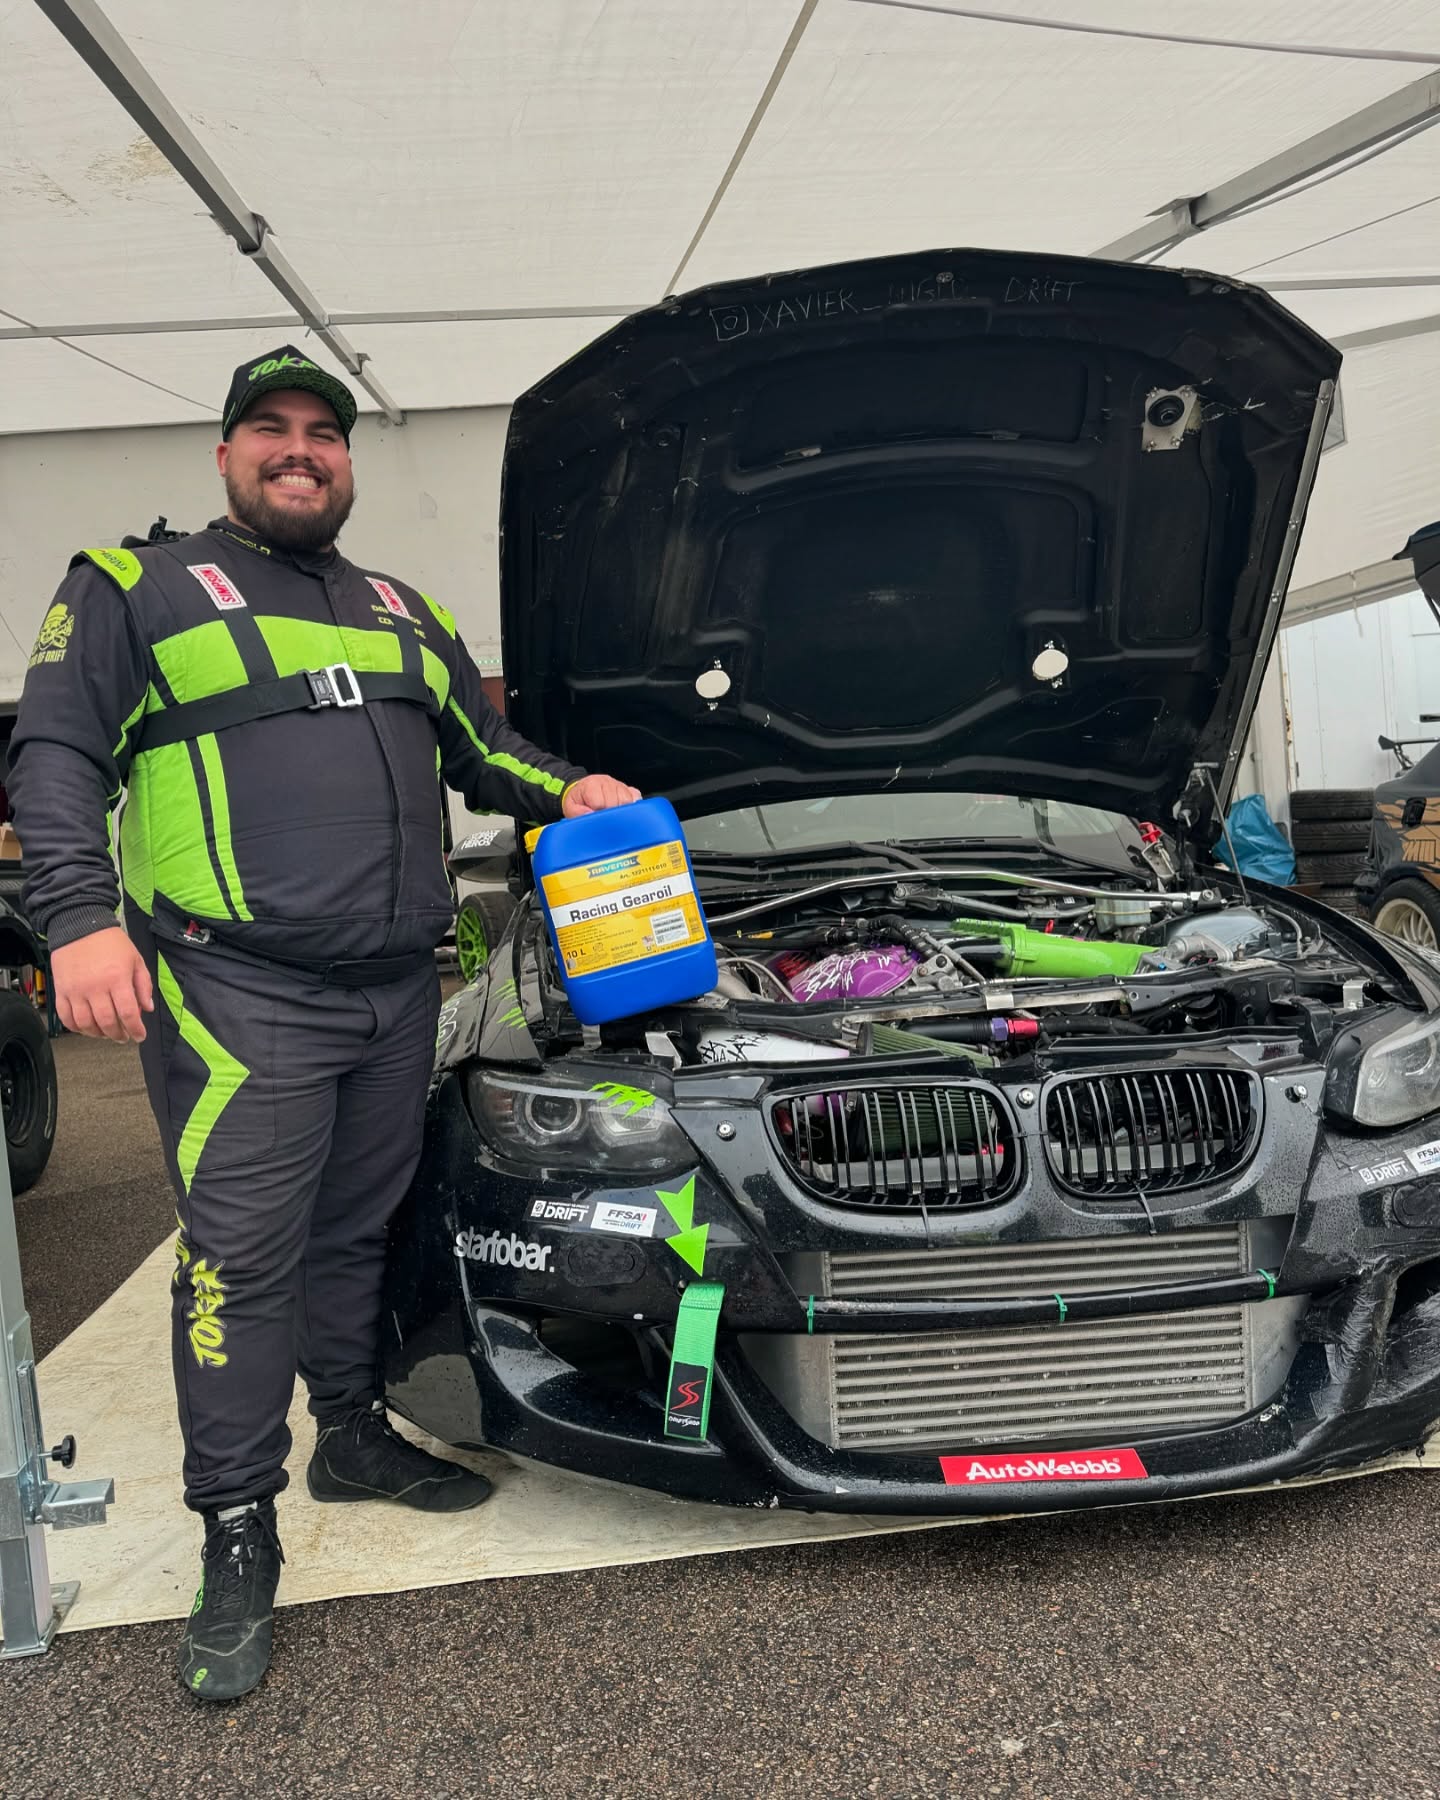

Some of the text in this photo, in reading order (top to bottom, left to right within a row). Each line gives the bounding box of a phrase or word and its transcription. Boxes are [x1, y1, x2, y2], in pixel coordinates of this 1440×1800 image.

[201, 568, 236, 604] SIMPSON
[591, 857, 637, 876] RAVENOL
[569, 902, 619, 922] Racing
[621, 884, 672, 908] Gearoil
[566, 948, 586, 959] 10 L
[1372, 1160, 1409, 1181] DRIFT
[543, 1205, 589, 1222] DRIFT
[607, 1209, 643, 1221] FFSA
